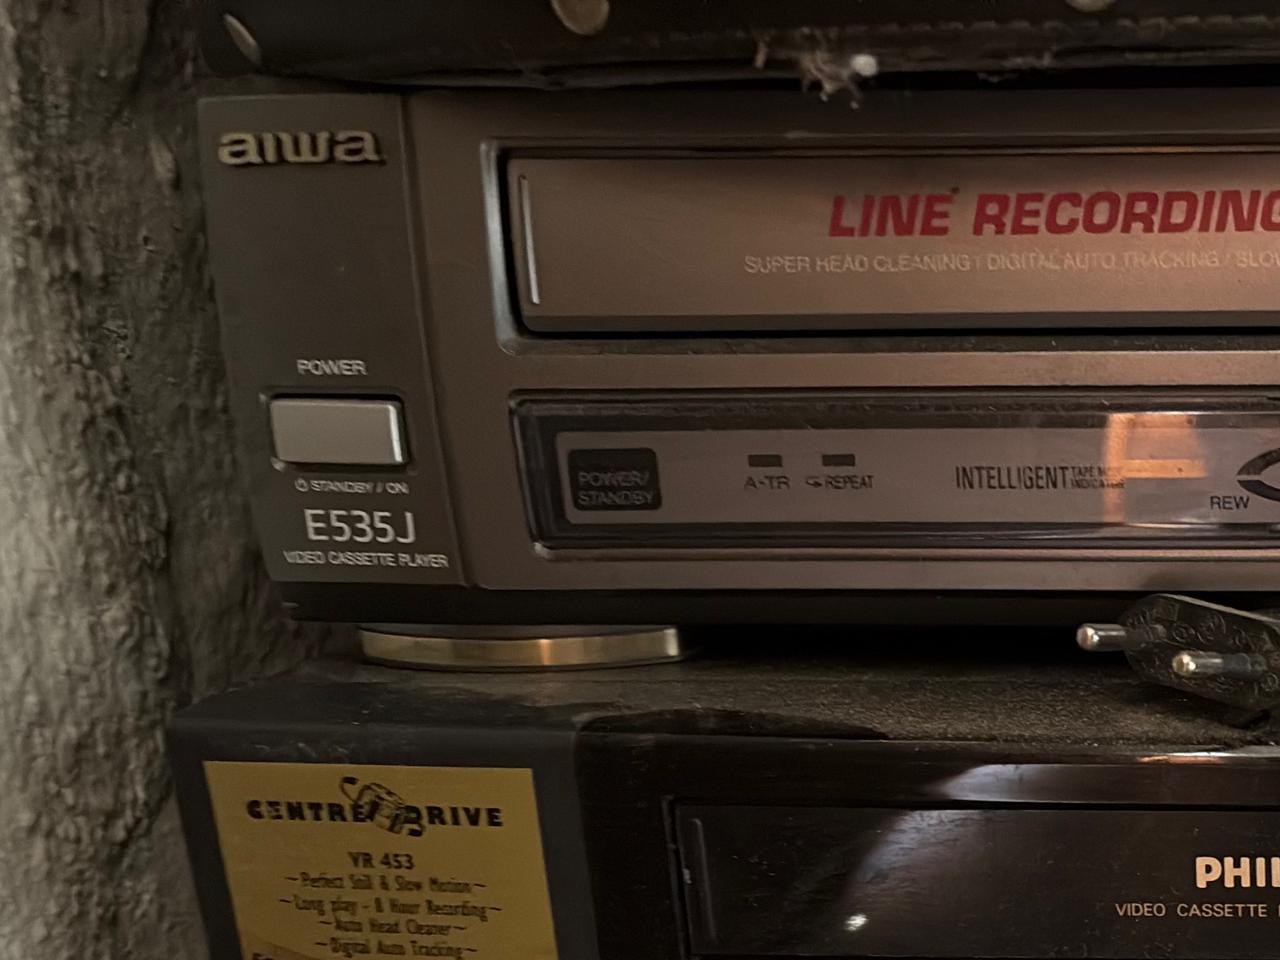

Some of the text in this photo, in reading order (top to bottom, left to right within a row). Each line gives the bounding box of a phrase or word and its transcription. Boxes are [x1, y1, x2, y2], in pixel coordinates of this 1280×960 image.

[217, 129, 380, 165] aiwa
[828, 193, 955, 238] LINE
[743, 255, 812, 273] SUPER
[815, 255, 868, 272] HEAD
[873, 254, 970, 272] CLEANING
[987, 252, 1060, 271] DIGITAL
[1063, 251, 1117, 269] AUTO
[1122, 250, 1220, 268] TRACKING
[296, 359, 368, 376] POWER
[823, 475, 875, 490] REPEAT
[955, 465, 1068, 490] INTELLIGENT
[310, 480, 371, 494] STANDBY
[386, 482, 411, 495] ON
[577, 490, 654, 505] STANDBY
[1209, 495, 1250, 511] REW
[303, 508, 417, 544] E535J
[283, 550, 450, 568] VIDEO CASSETTE PLAYER
[347, 852, 415, 870] VR 453
[1115, 903, 1167, 918] VIDEO
[1176, 903, 1268, 918] CASSETTE
